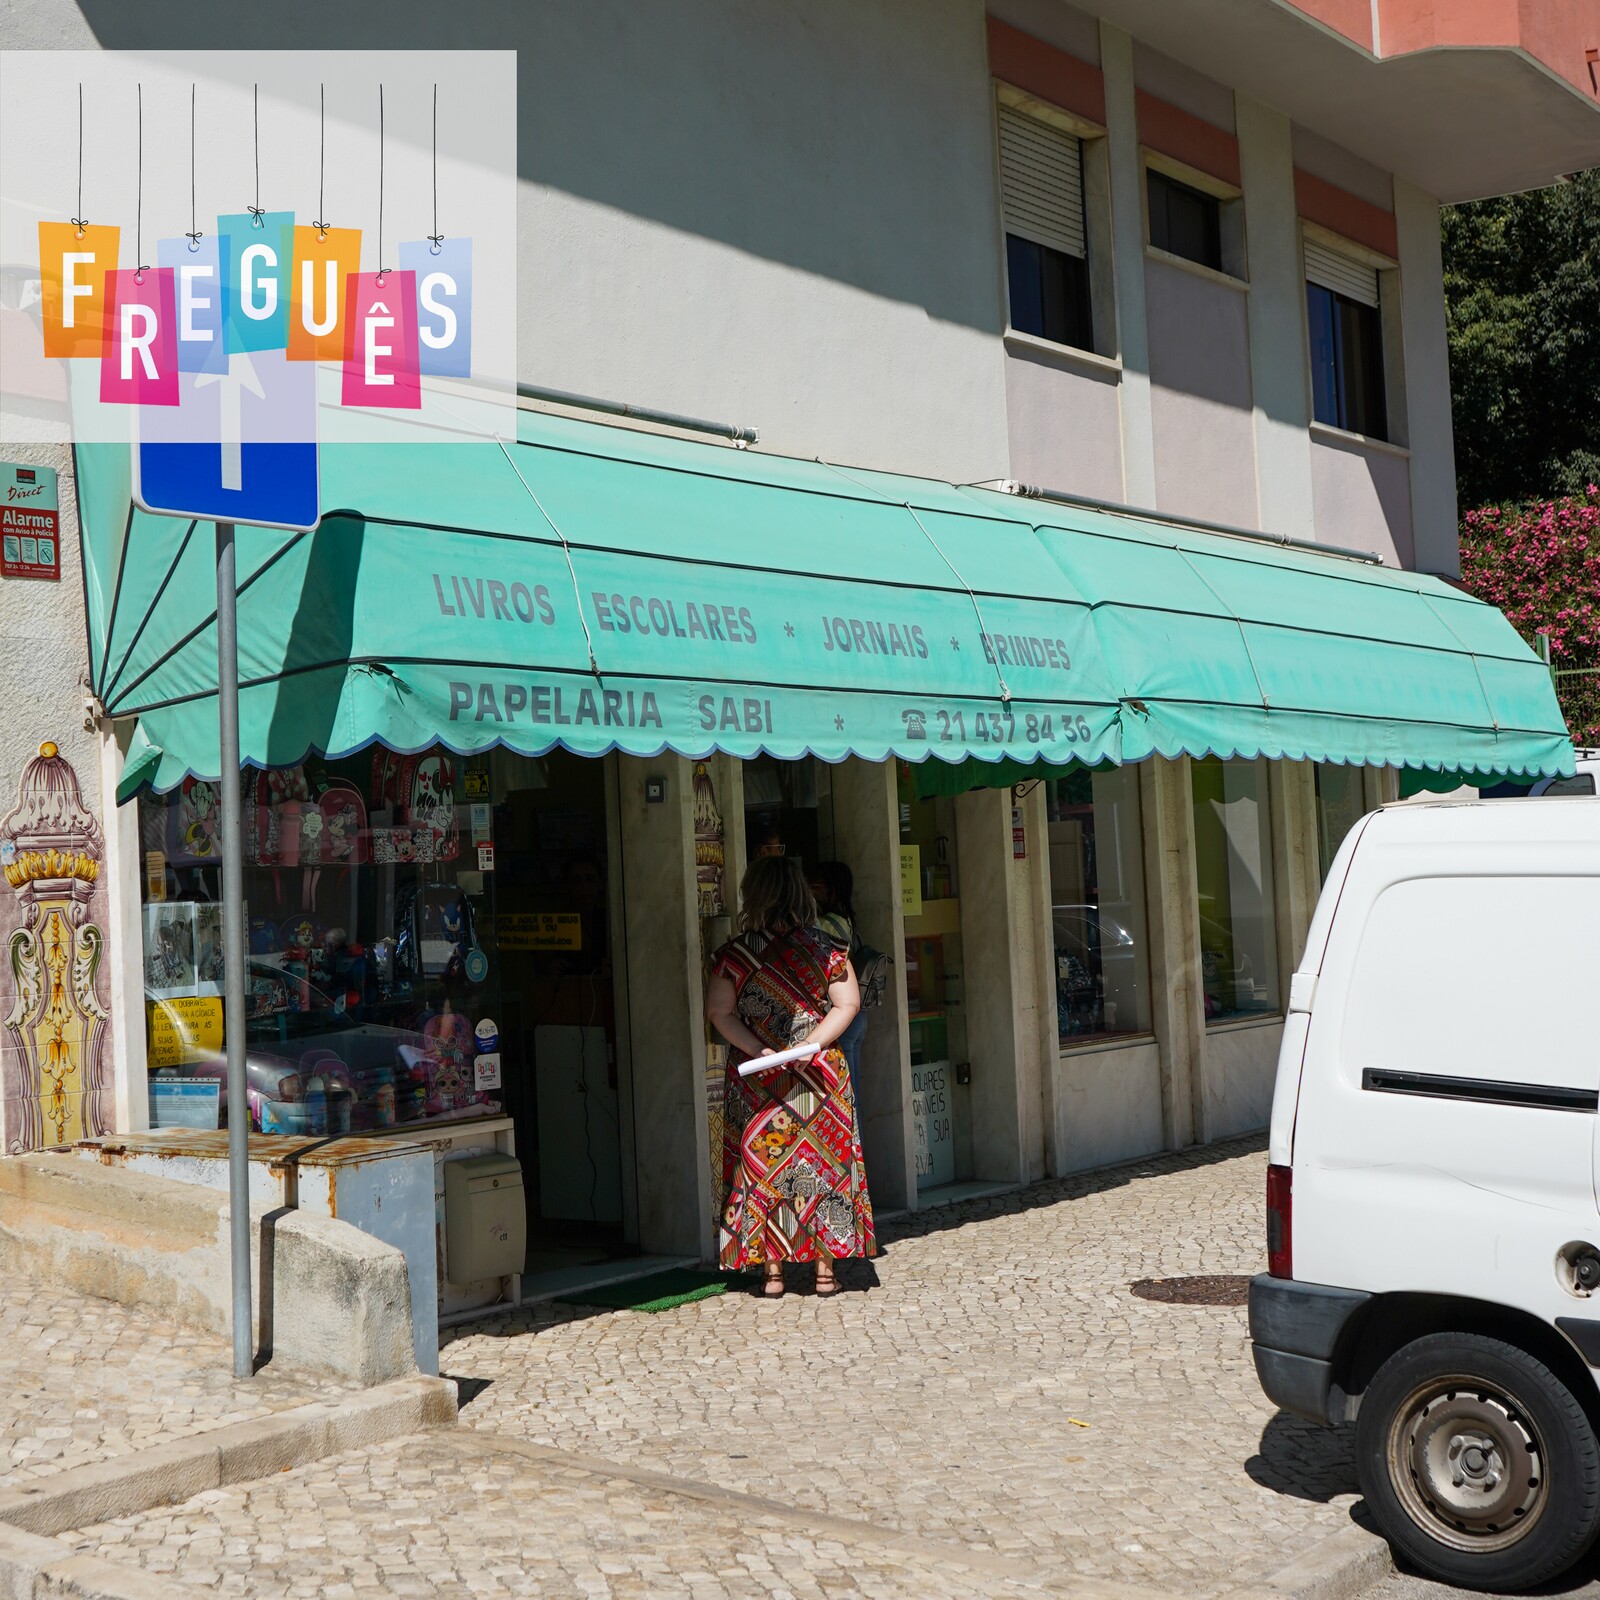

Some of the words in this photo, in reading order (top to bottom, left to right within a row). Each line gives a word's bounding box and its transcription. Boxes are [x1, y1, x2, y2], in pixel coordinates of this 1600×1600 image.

[7, 485, 47, 501] Direct
[3, 510, 54, 528] Alarme
[432, 573, 556, 625] LIVROS
[591, 591, 757, 645] ESCOLARES
[821, 616, 929, 660] JORNAIS
[979, 632, 1072, 671] BRINDES
[448, 681, 663, 729] PAPELARIA
[698, 694, 773, 734] SABI
[936, 709, 967, 742] 21
[975, 711, 1016, 743] 437
[1025, 713, 1056, 743] 84
[1061, 714, 1092, 743] 36
[157, 1035, 173, 1044] SUAS
[912, 1067, 945, 1093] OLARES
[933, 1118, 950, 1143] SUA
